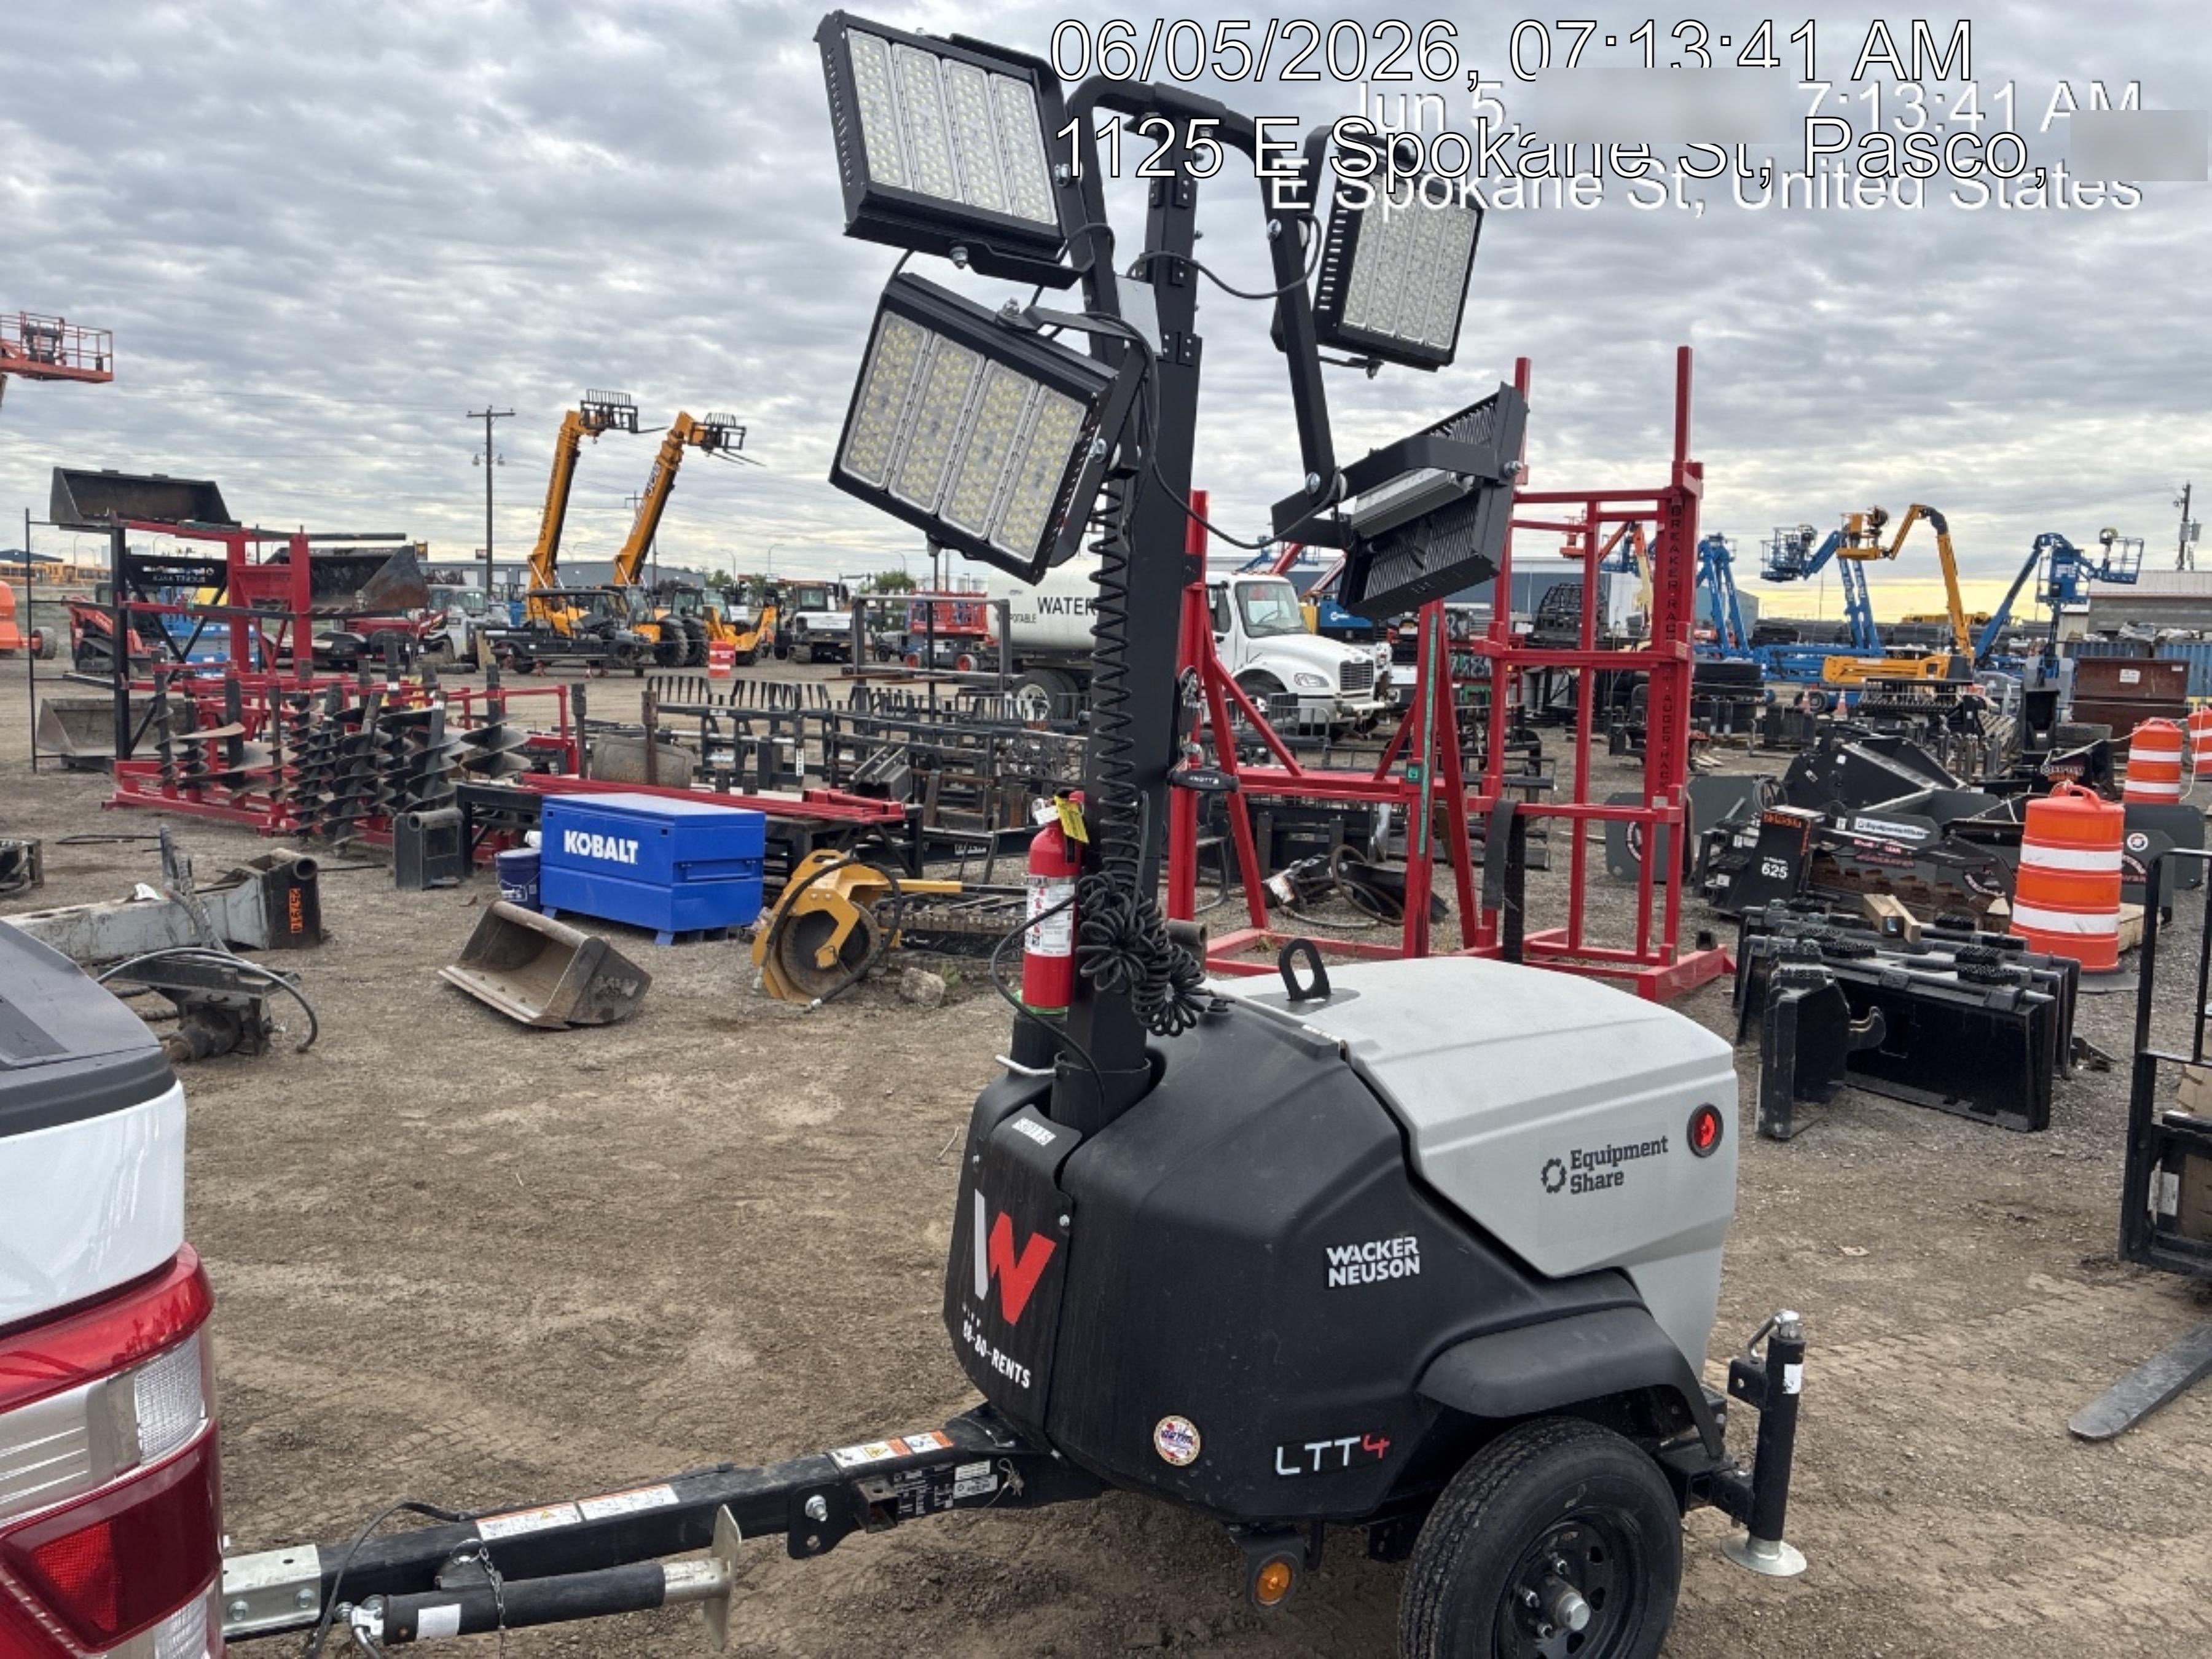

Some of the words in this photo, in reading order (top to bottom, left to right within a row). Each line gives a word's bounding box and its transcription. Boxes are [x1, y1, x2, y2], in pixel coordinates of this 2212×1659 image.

[1037, 597, 1096, 616] WATER
[563, 829, 639, 865] KOBALT
[1761, 862, 1789, 880] 625
[1569, 1135, 1668, 1171] Equipment
[1569, 1169, 1625, 1195] Share
[1326, 1236, 1419, 1266] WACKER
[1328, 1257, 1421, 1288] NEUSON
[1276, 1434, 1390, 1476] LTT4
